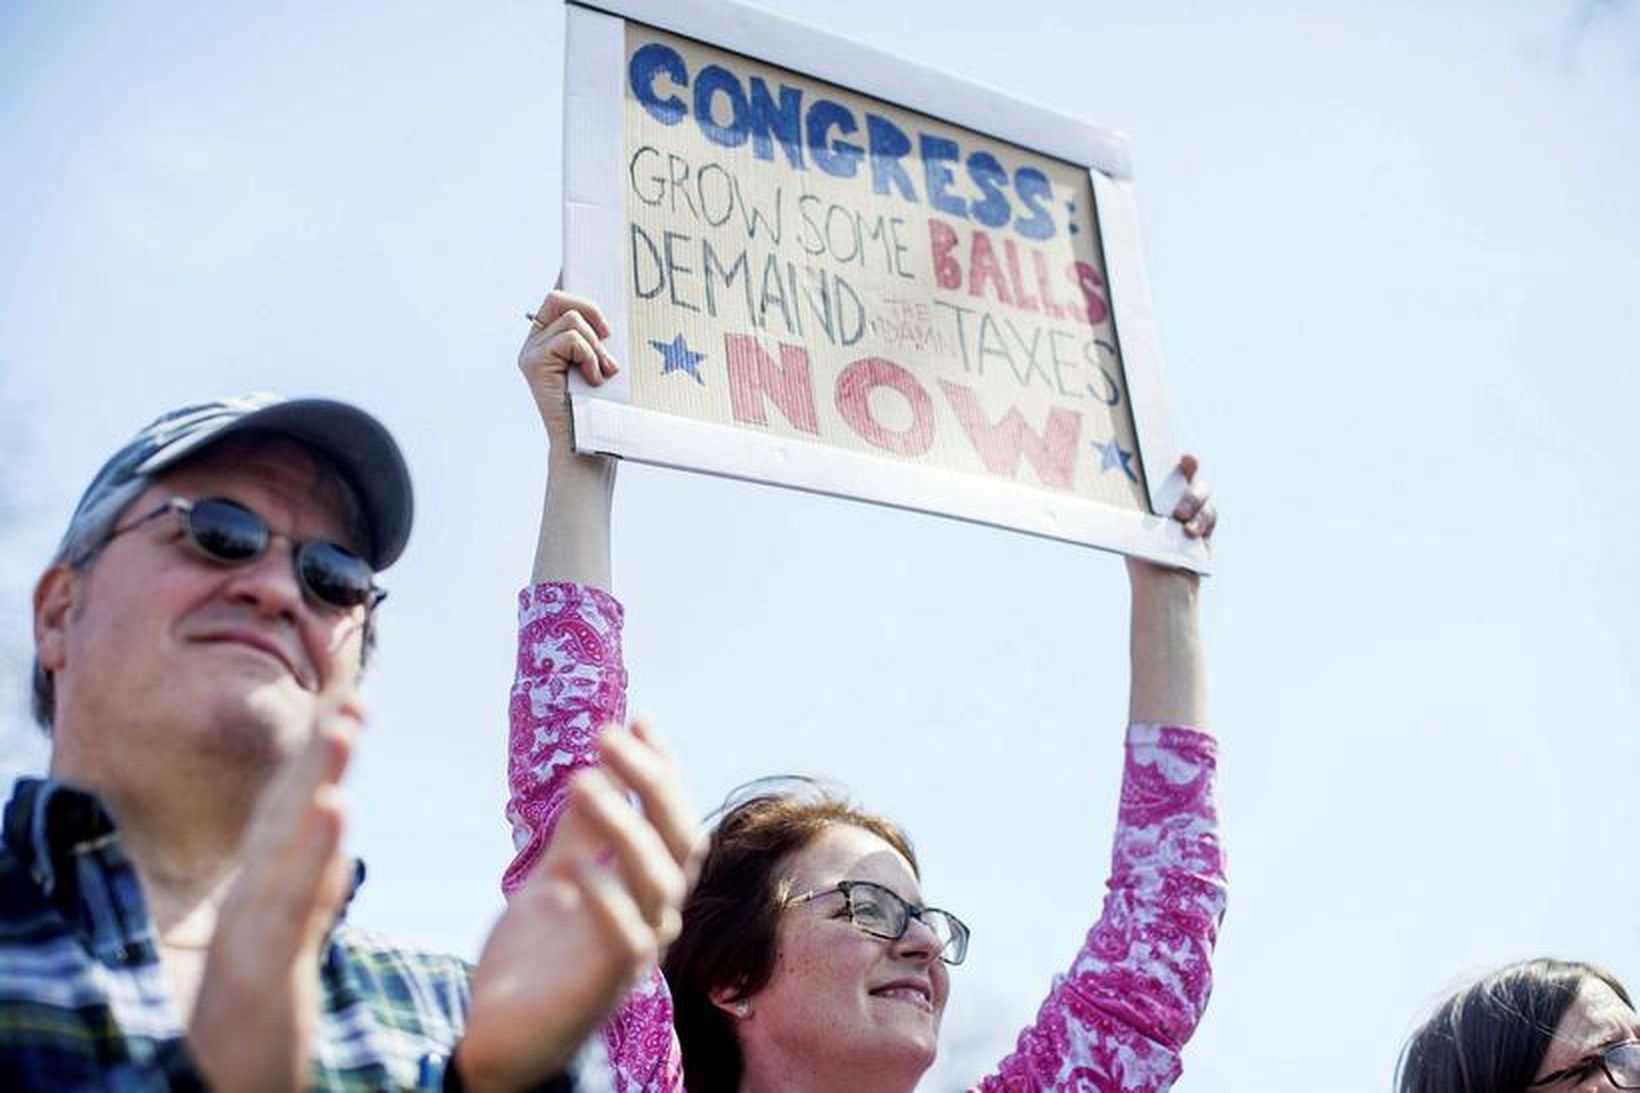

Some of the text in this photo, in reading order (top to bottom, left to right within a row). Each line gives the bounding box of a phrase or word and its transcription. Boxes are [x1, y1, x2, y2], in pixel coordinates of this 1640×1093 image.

[629, 43, 1079, 240] CONGRESS:
[630, 146, 1107, 325] GROW SOME BALLS
[632, 222, 865, 345] DEMAND
[934, 299, 1120, 406] TAXES
[723, 332, 1083, 491] NOW
